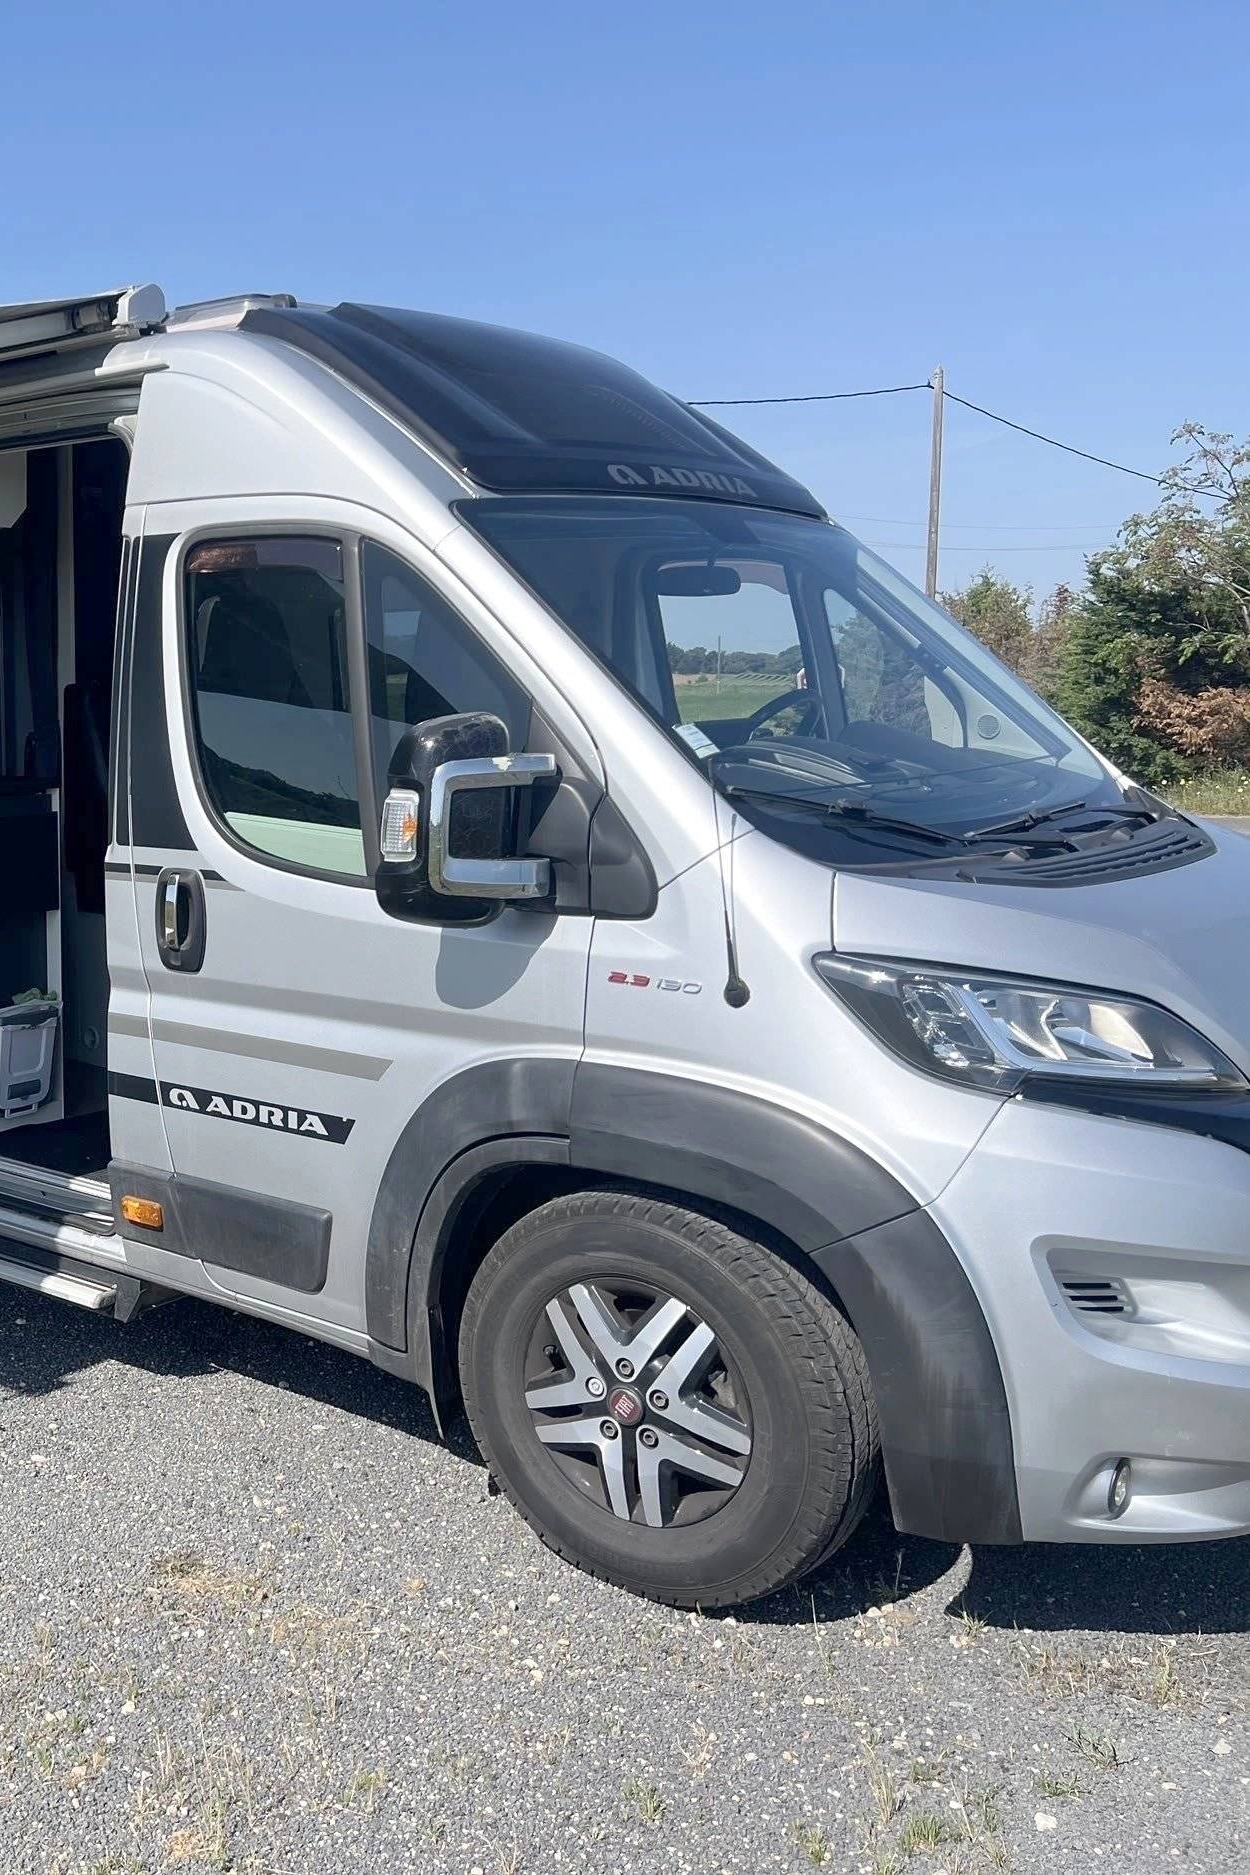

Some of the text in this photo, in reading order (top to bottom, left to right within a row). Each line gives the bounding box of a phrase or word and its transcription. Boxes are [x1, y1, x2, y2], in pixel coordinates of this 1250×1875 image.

[650, 466, 758, 498] ADRIA
[608, 971, 702, 995] 2.3 130
[205, 1095, 329, 1136] ADRIA
[614, 1394, 635, 1418] FIAT
